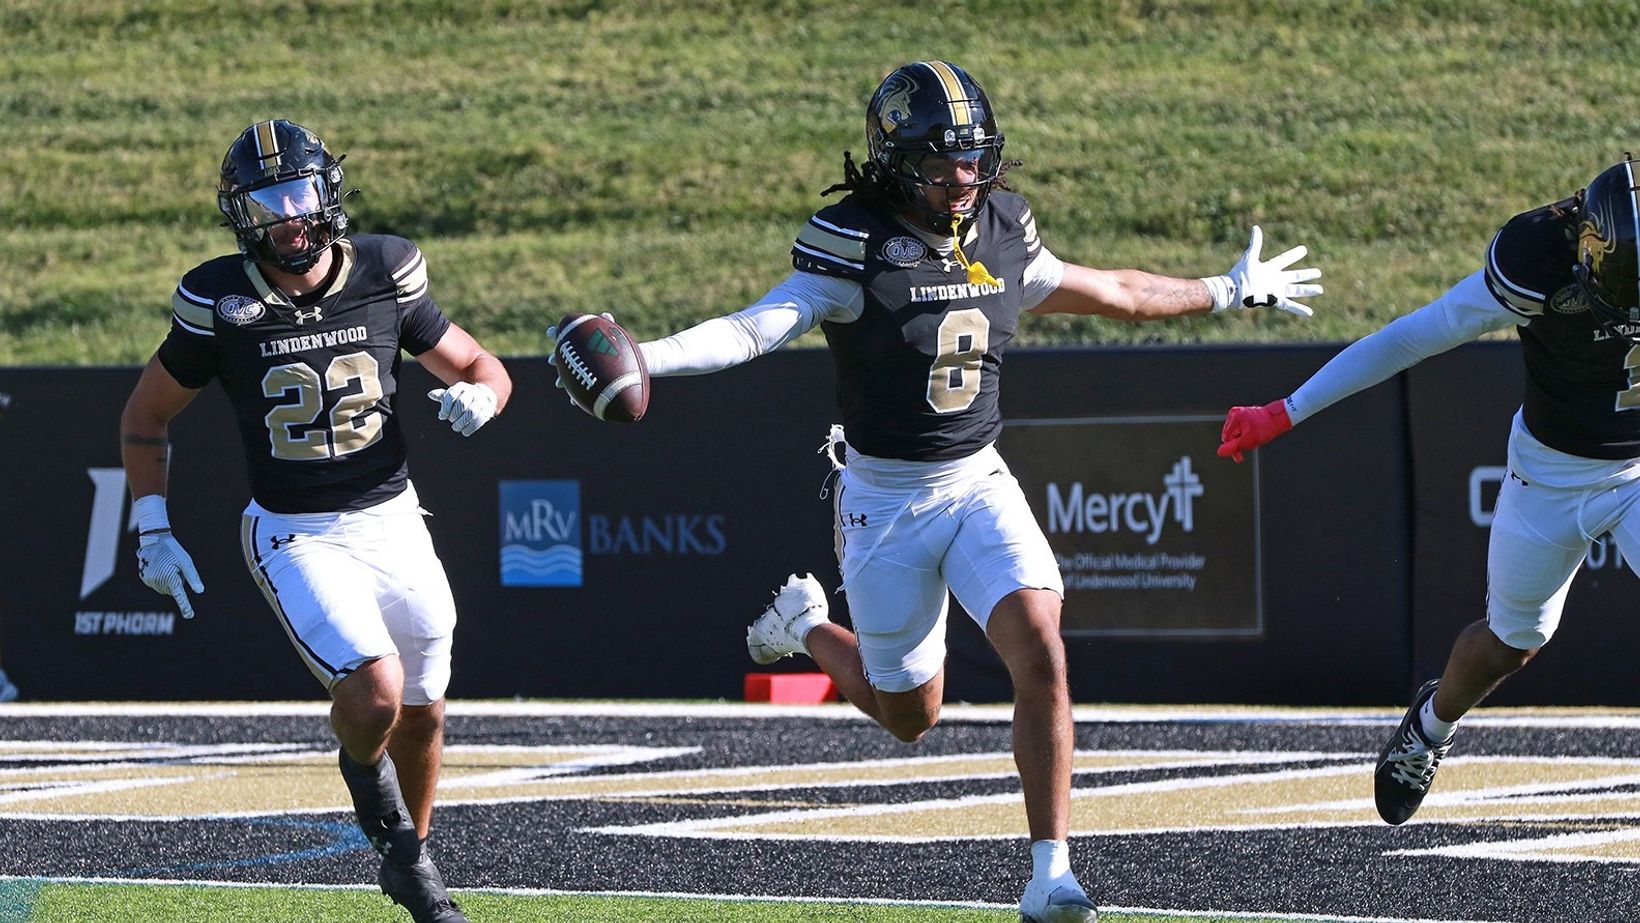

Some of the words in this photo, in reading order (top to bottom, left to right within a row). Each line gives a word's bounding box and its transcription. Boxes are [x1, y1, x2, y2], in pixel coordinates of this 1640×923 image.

[910, 278, 1005, 302] LINDENWOOD
[259, 326, 368, 357] LINDENWOOD
[926, 308, 990, 415] 8
[261, 351, 384, 460] 22
[505, 499, 576, 541] MRV
[588, 514, 727, 555] BANKS
[1046, 481, 1169, 544] Mercy
[1074, 552, 1114, 570] Official
[1115, 552, 1157, 570] Medical
[1161, 552, 1206, 570] Provider
[1077, 573, 1140, 590] Lindenwood
[1142, 573, 1197, 592] University
[103, 612, 175, 635] PHORM
